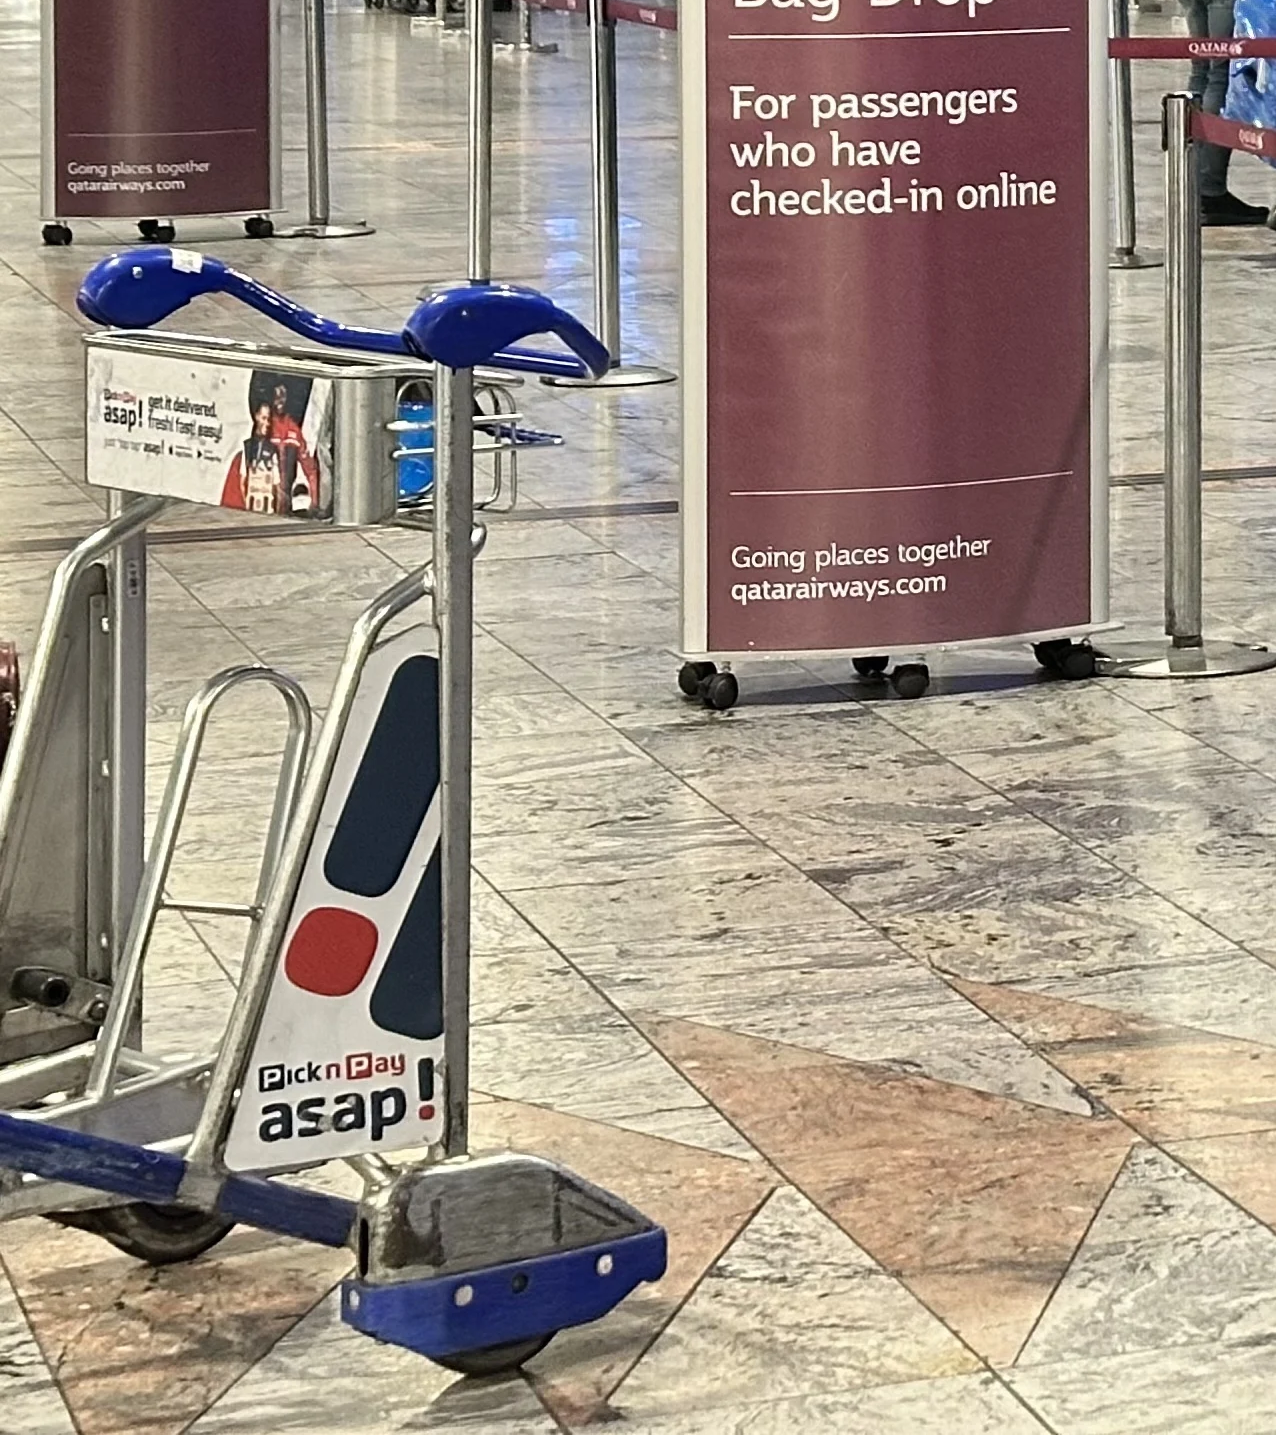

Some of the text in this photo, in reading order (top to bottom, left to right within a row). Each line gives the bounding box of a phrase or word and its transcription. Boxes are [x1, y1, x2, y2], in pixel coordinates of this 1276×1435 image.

[1188, 42, 1230, 55] QATAR
[728, 85, 1019, 130] For passengers
[728, 130, 922, 169] who have
[67, 159, 211, 178] Going places together
[67, 178, 187, 195] qatarairways.com
[728, 172, 1059, 218] checked-in online
[103, 399, 143, 433] asap!
[730, 534, 993, 574] Going places together
[730, 574, 948, 606] qatarairways.com
[258, 1051, 406, 1093] Pick n Pay
